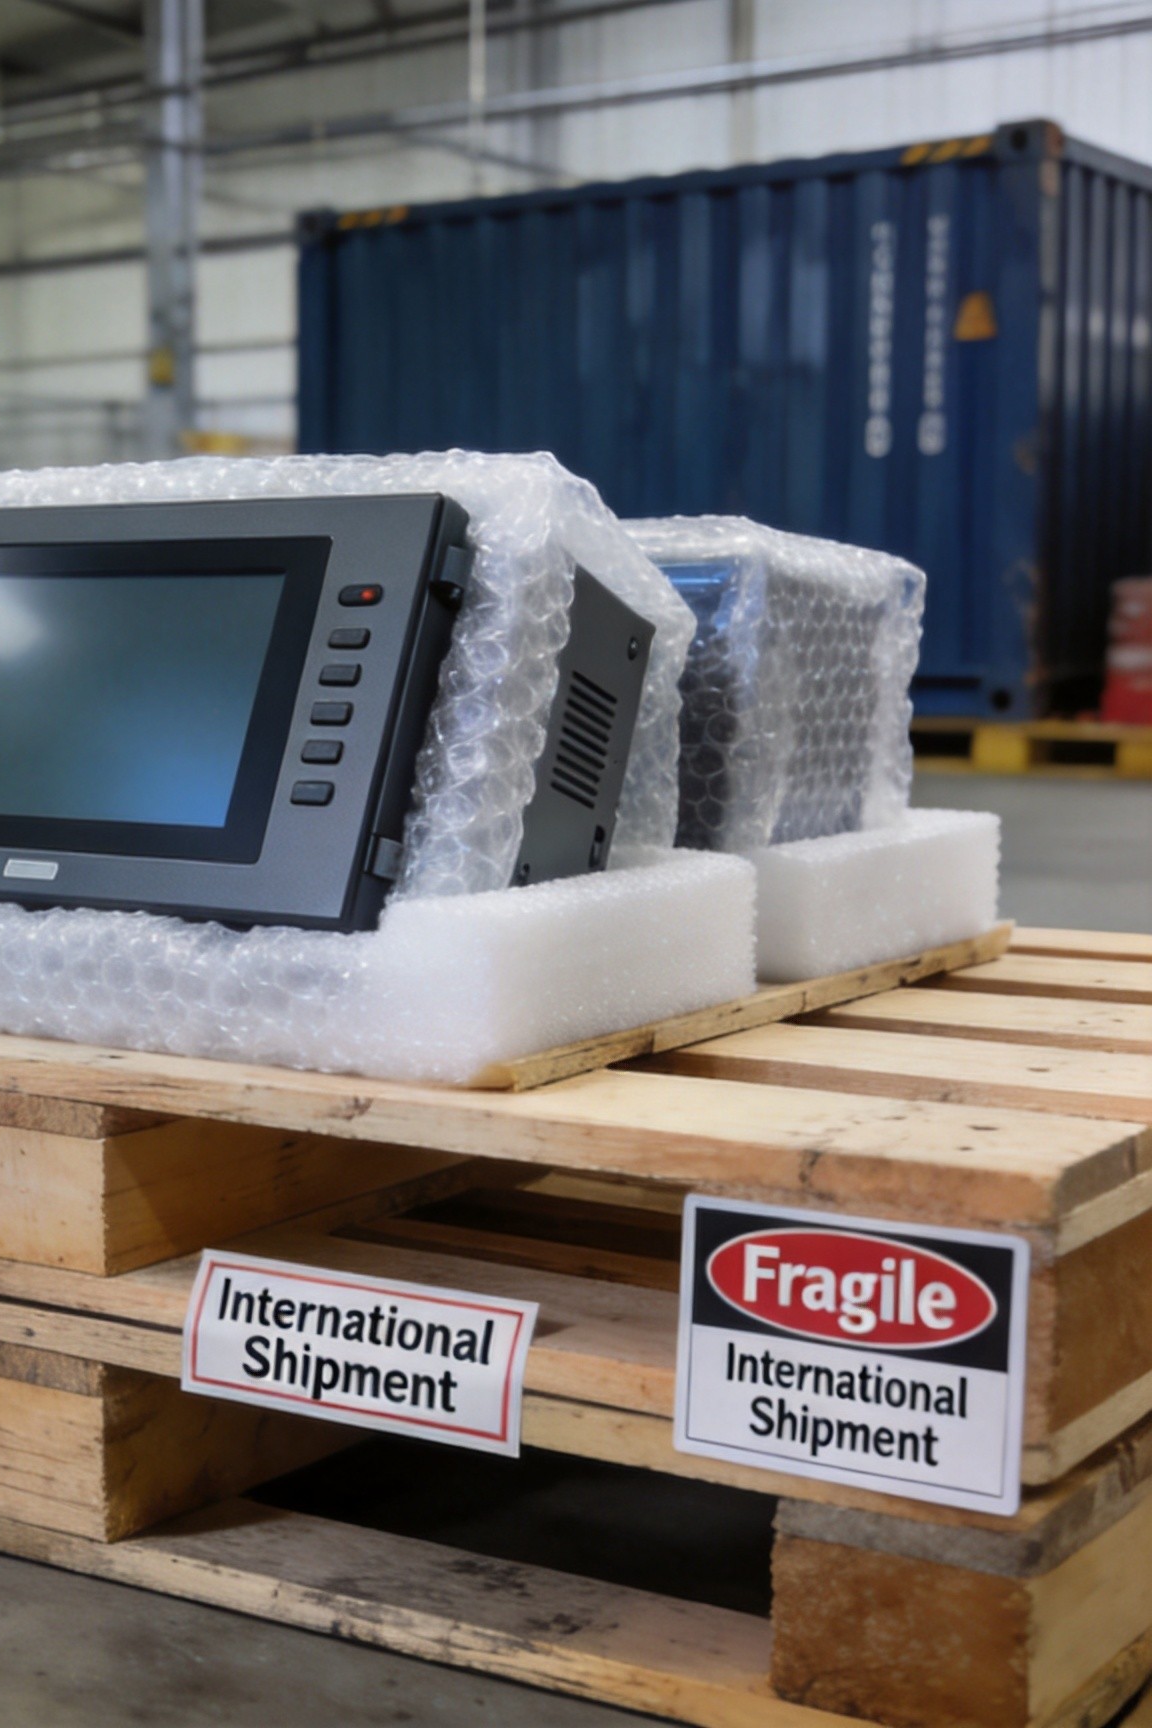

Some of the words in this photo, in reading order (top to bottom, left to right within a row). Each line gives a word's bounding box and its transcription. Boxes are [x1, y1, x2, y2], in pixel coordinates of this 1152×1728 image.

[218, 1277, 495, 1366] International
[742, 1242, 957, 1335] Fragile
[242, 1336, 458, 1412] Shipment
[726, 1342, 969, 1419] International
[749, 1397, 940, 1468] Shipment
